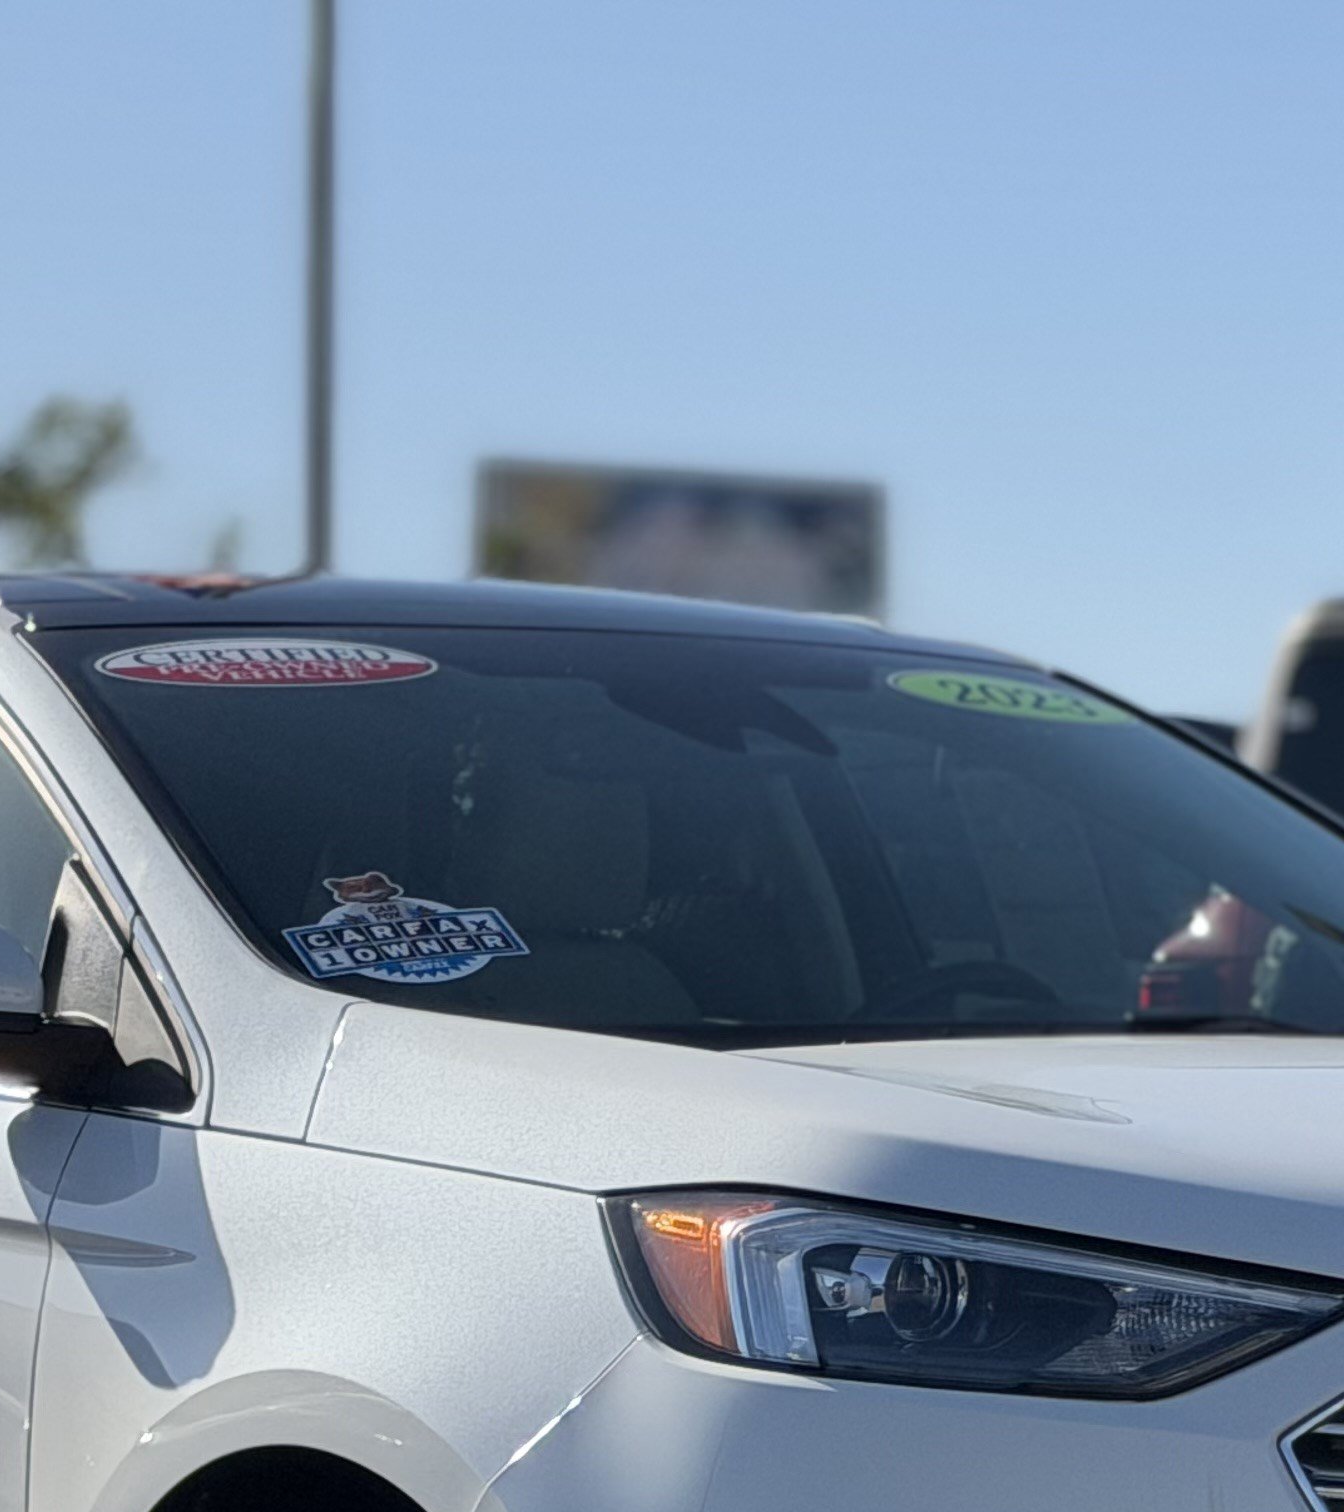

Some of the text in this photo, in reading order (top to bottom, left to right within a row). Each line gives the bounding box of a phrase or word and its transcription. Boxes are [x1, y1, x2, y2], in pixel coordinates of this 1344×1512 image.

[132, 648, 391, 666] CERTIFIED
[156, 660, 390, 675] PRE-OWNED
[198, 669, 367, 681] VEHICLE
[307, 917, 494, 947] CARFAX
[317, 935, 506, 967] 1 OWNER
